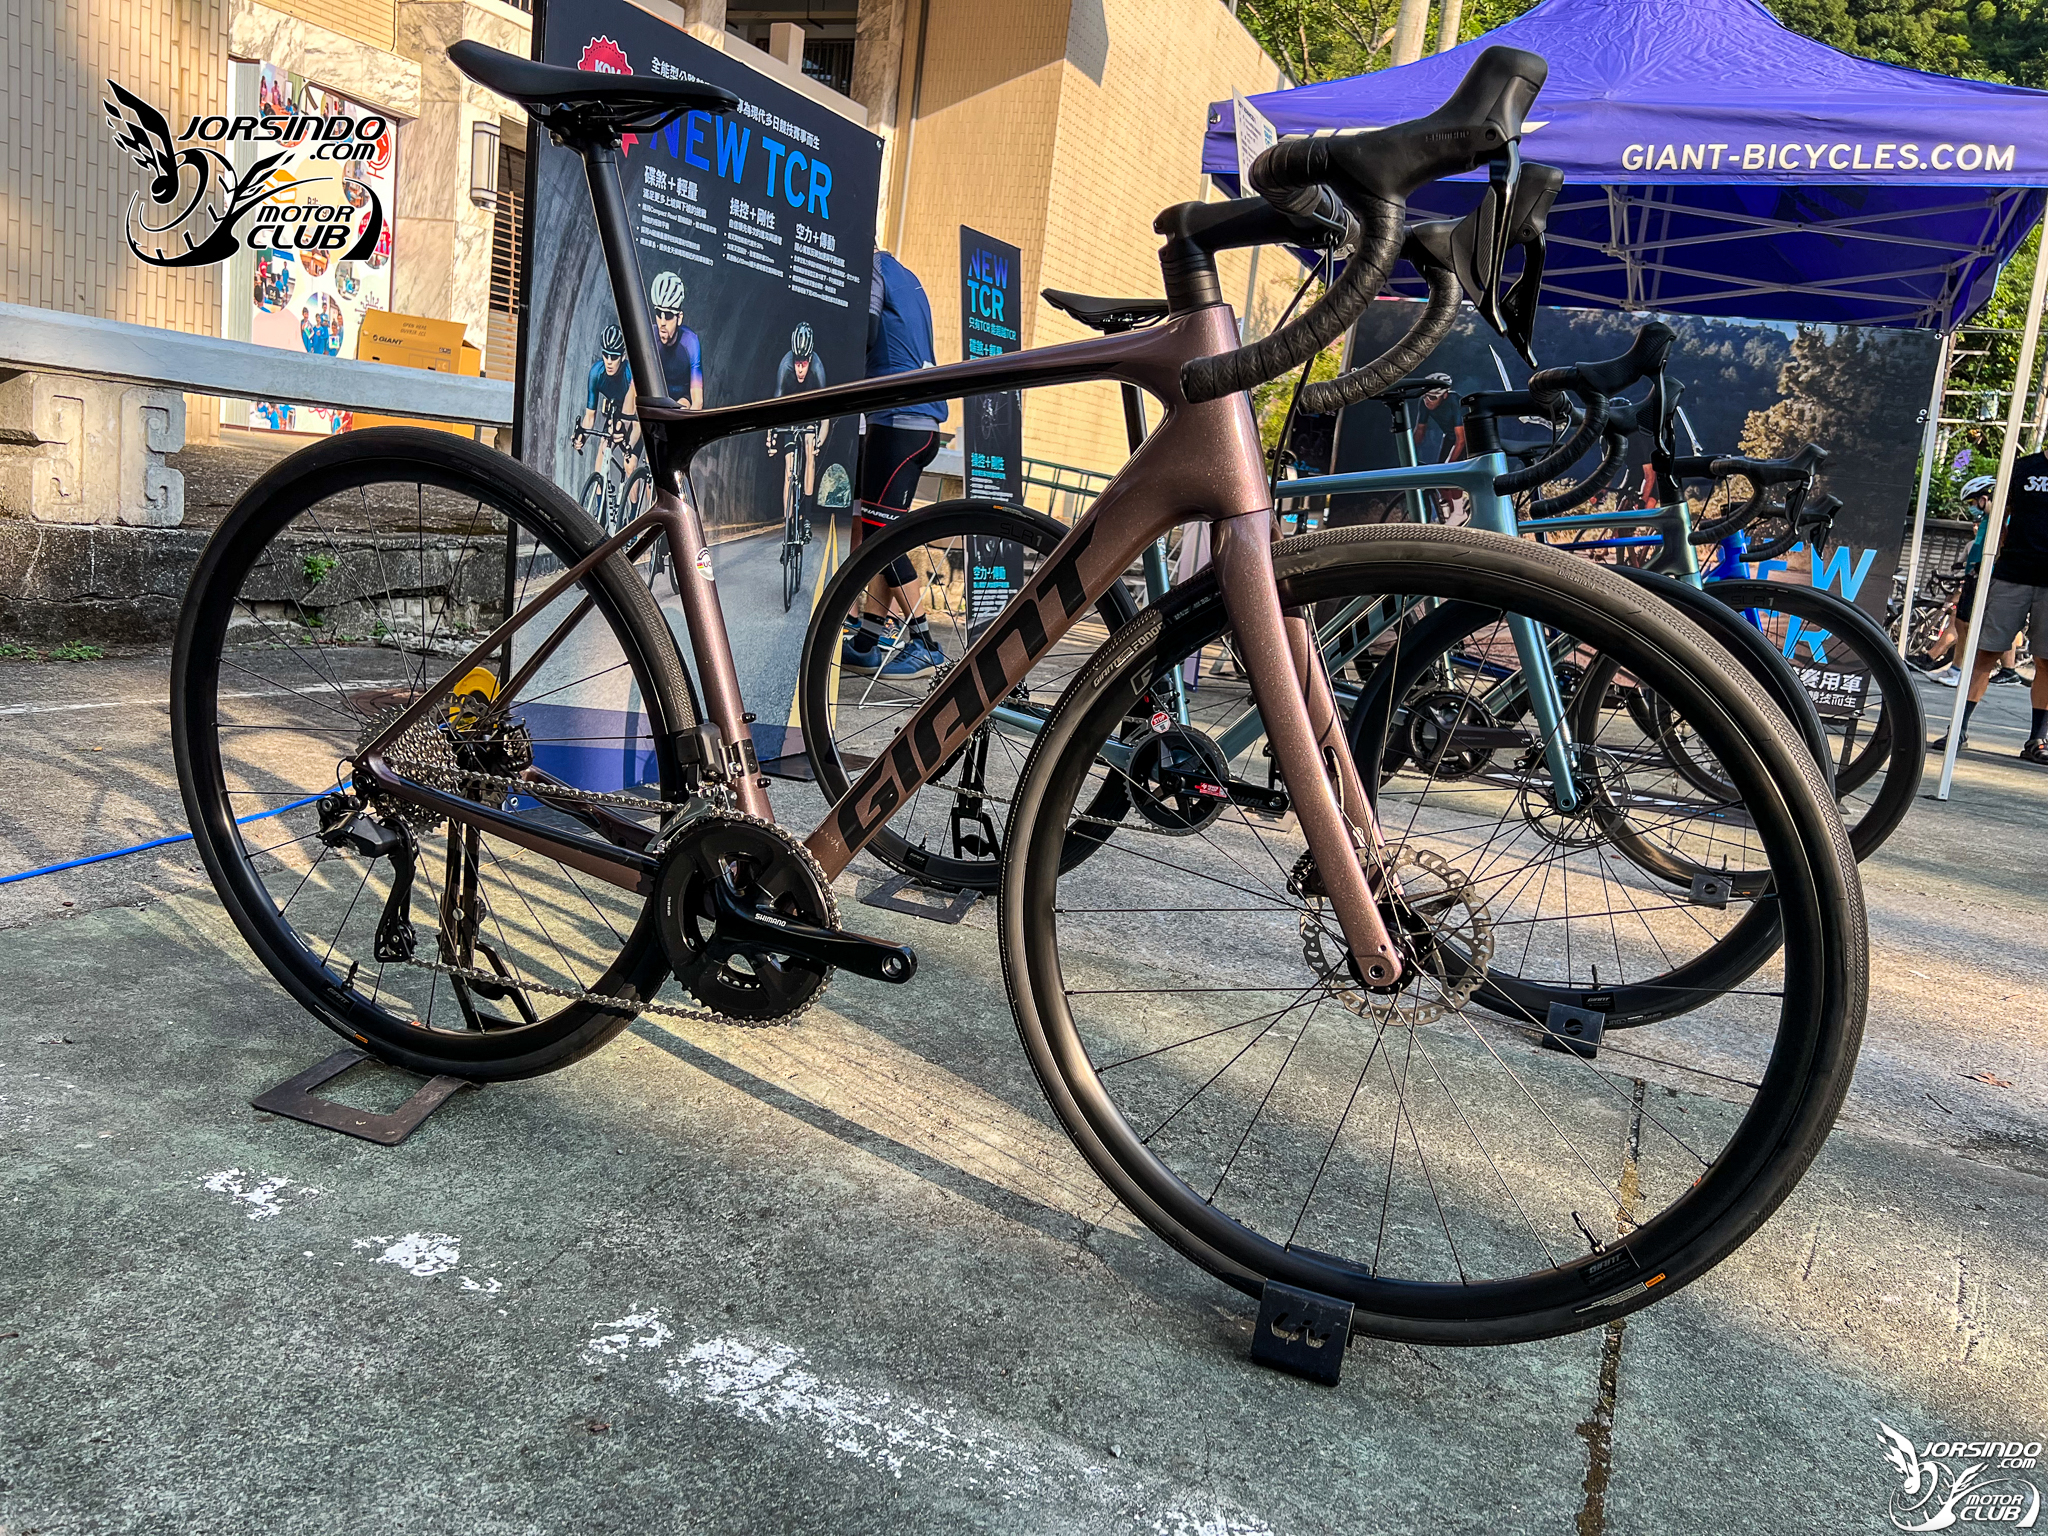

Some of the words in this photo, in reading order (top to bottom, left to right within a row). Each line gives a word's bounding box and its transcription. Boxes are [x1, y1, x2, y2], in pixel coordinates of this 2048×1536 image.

[649, 109, 751, 184] NEW
[762, 136, 833, 220] TCR
[1621, 143, 2016, 172] GIANT-BICYCLES.COM
[968, 247, 1009, 289] NEW
[967, 279, 1005, 322] TCR
[379, 336, 403, 346] GIANT
[1000, 522, 1034, 543] SLR
[837, 515, 1100, 854] GIANT
[1093, 658, 1121, 688] GIANT
[755, 913, 787, 927] SHIMANO
[1589, 1252, 1623, 1274] GIANT
